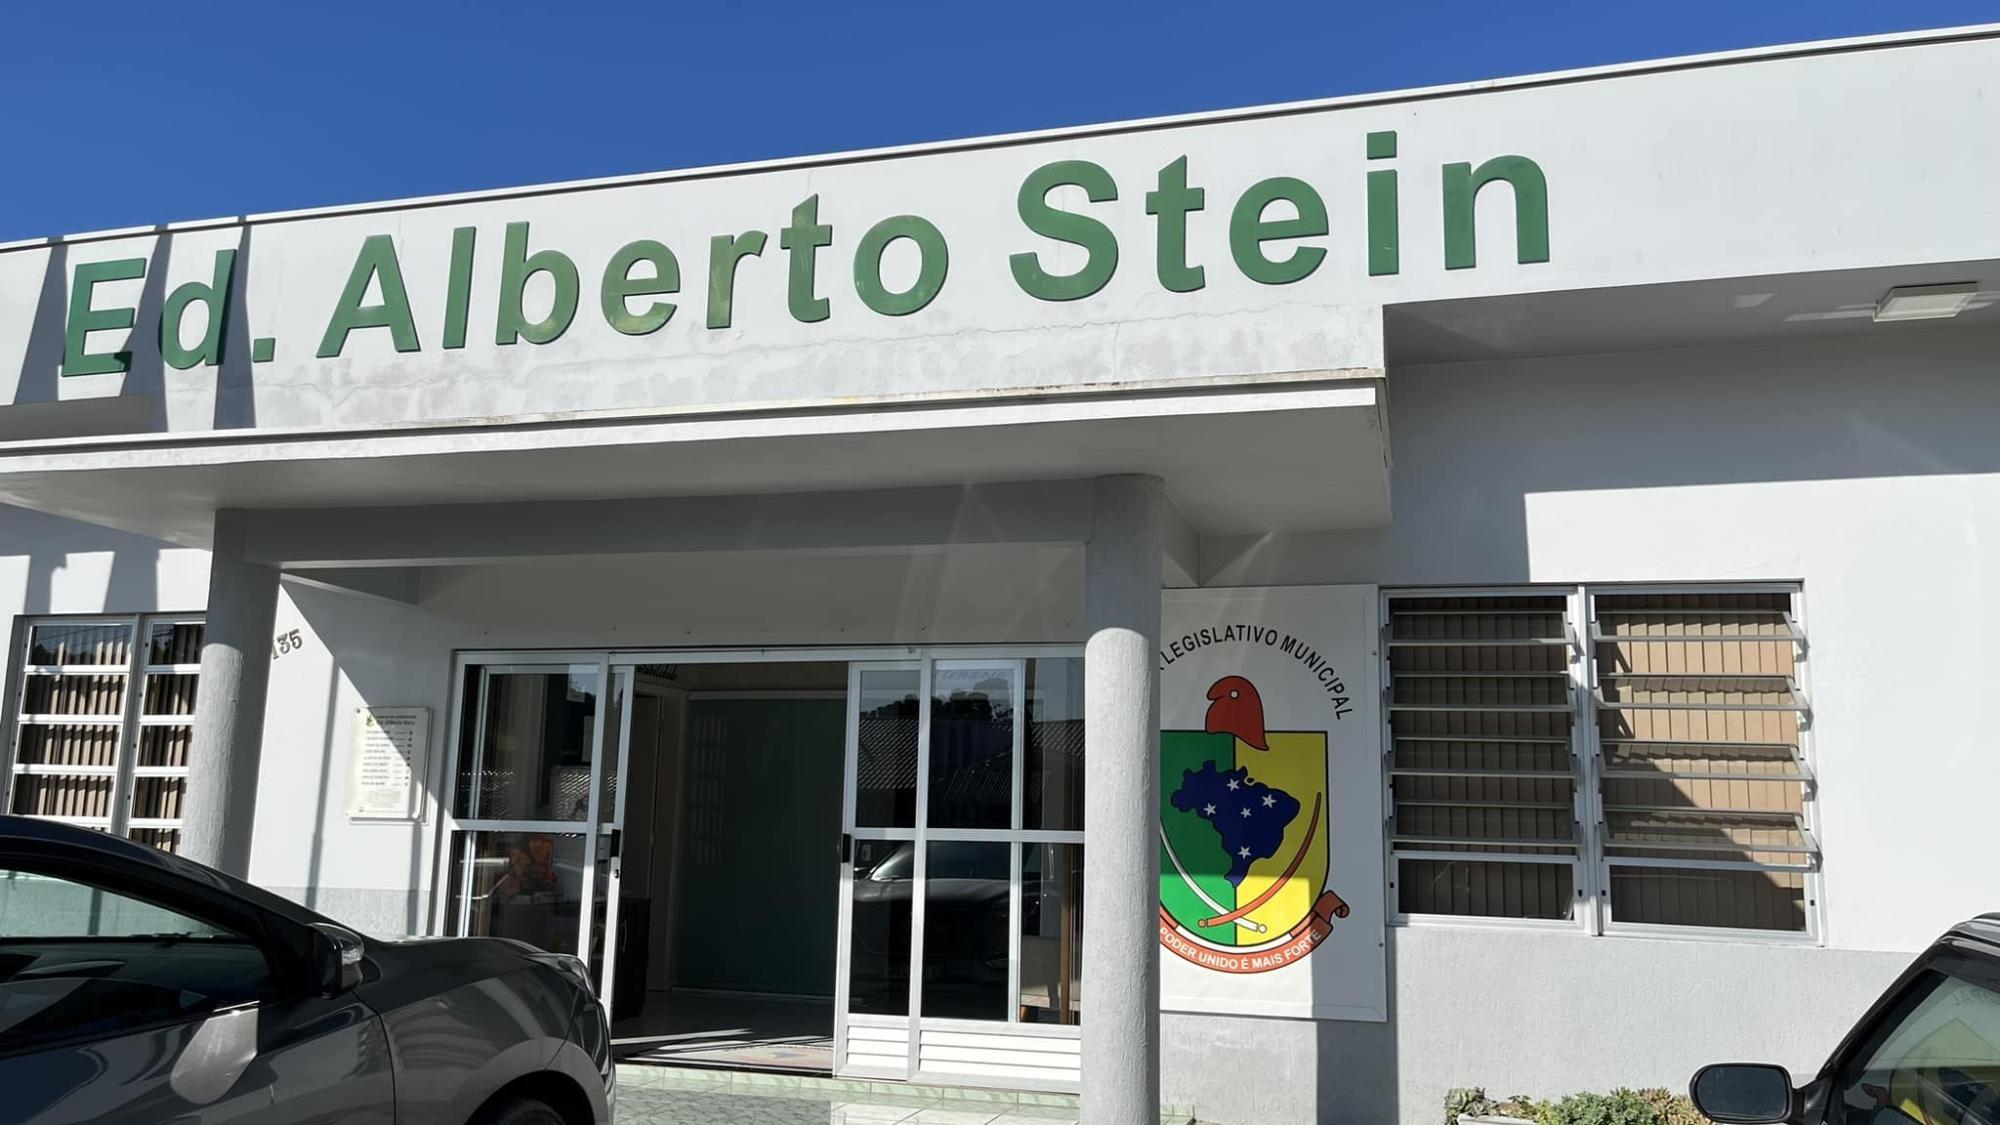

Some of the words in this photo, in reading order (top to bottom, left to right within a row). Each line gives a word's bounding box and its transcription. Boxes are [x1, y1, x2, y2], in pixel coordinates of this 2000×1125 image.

[61, 247, 275, 378] Ed.
[316, 193, 949, 359] Alberto
[1008, 130, 1550, 302] Stein
[1160, 624, 1278, 665] LEGISLATIVO
[1280, 634, 1353, 720] MUNICIPAL
[1160, 927, 1198, 959] PODER
[1198, 952, 1238, 970] UNIDO
[1240, 956, 1250, 970] É
[1251, 953, 1284, 969] MAIS
[1283, 928, 1322, 961] FORTE
